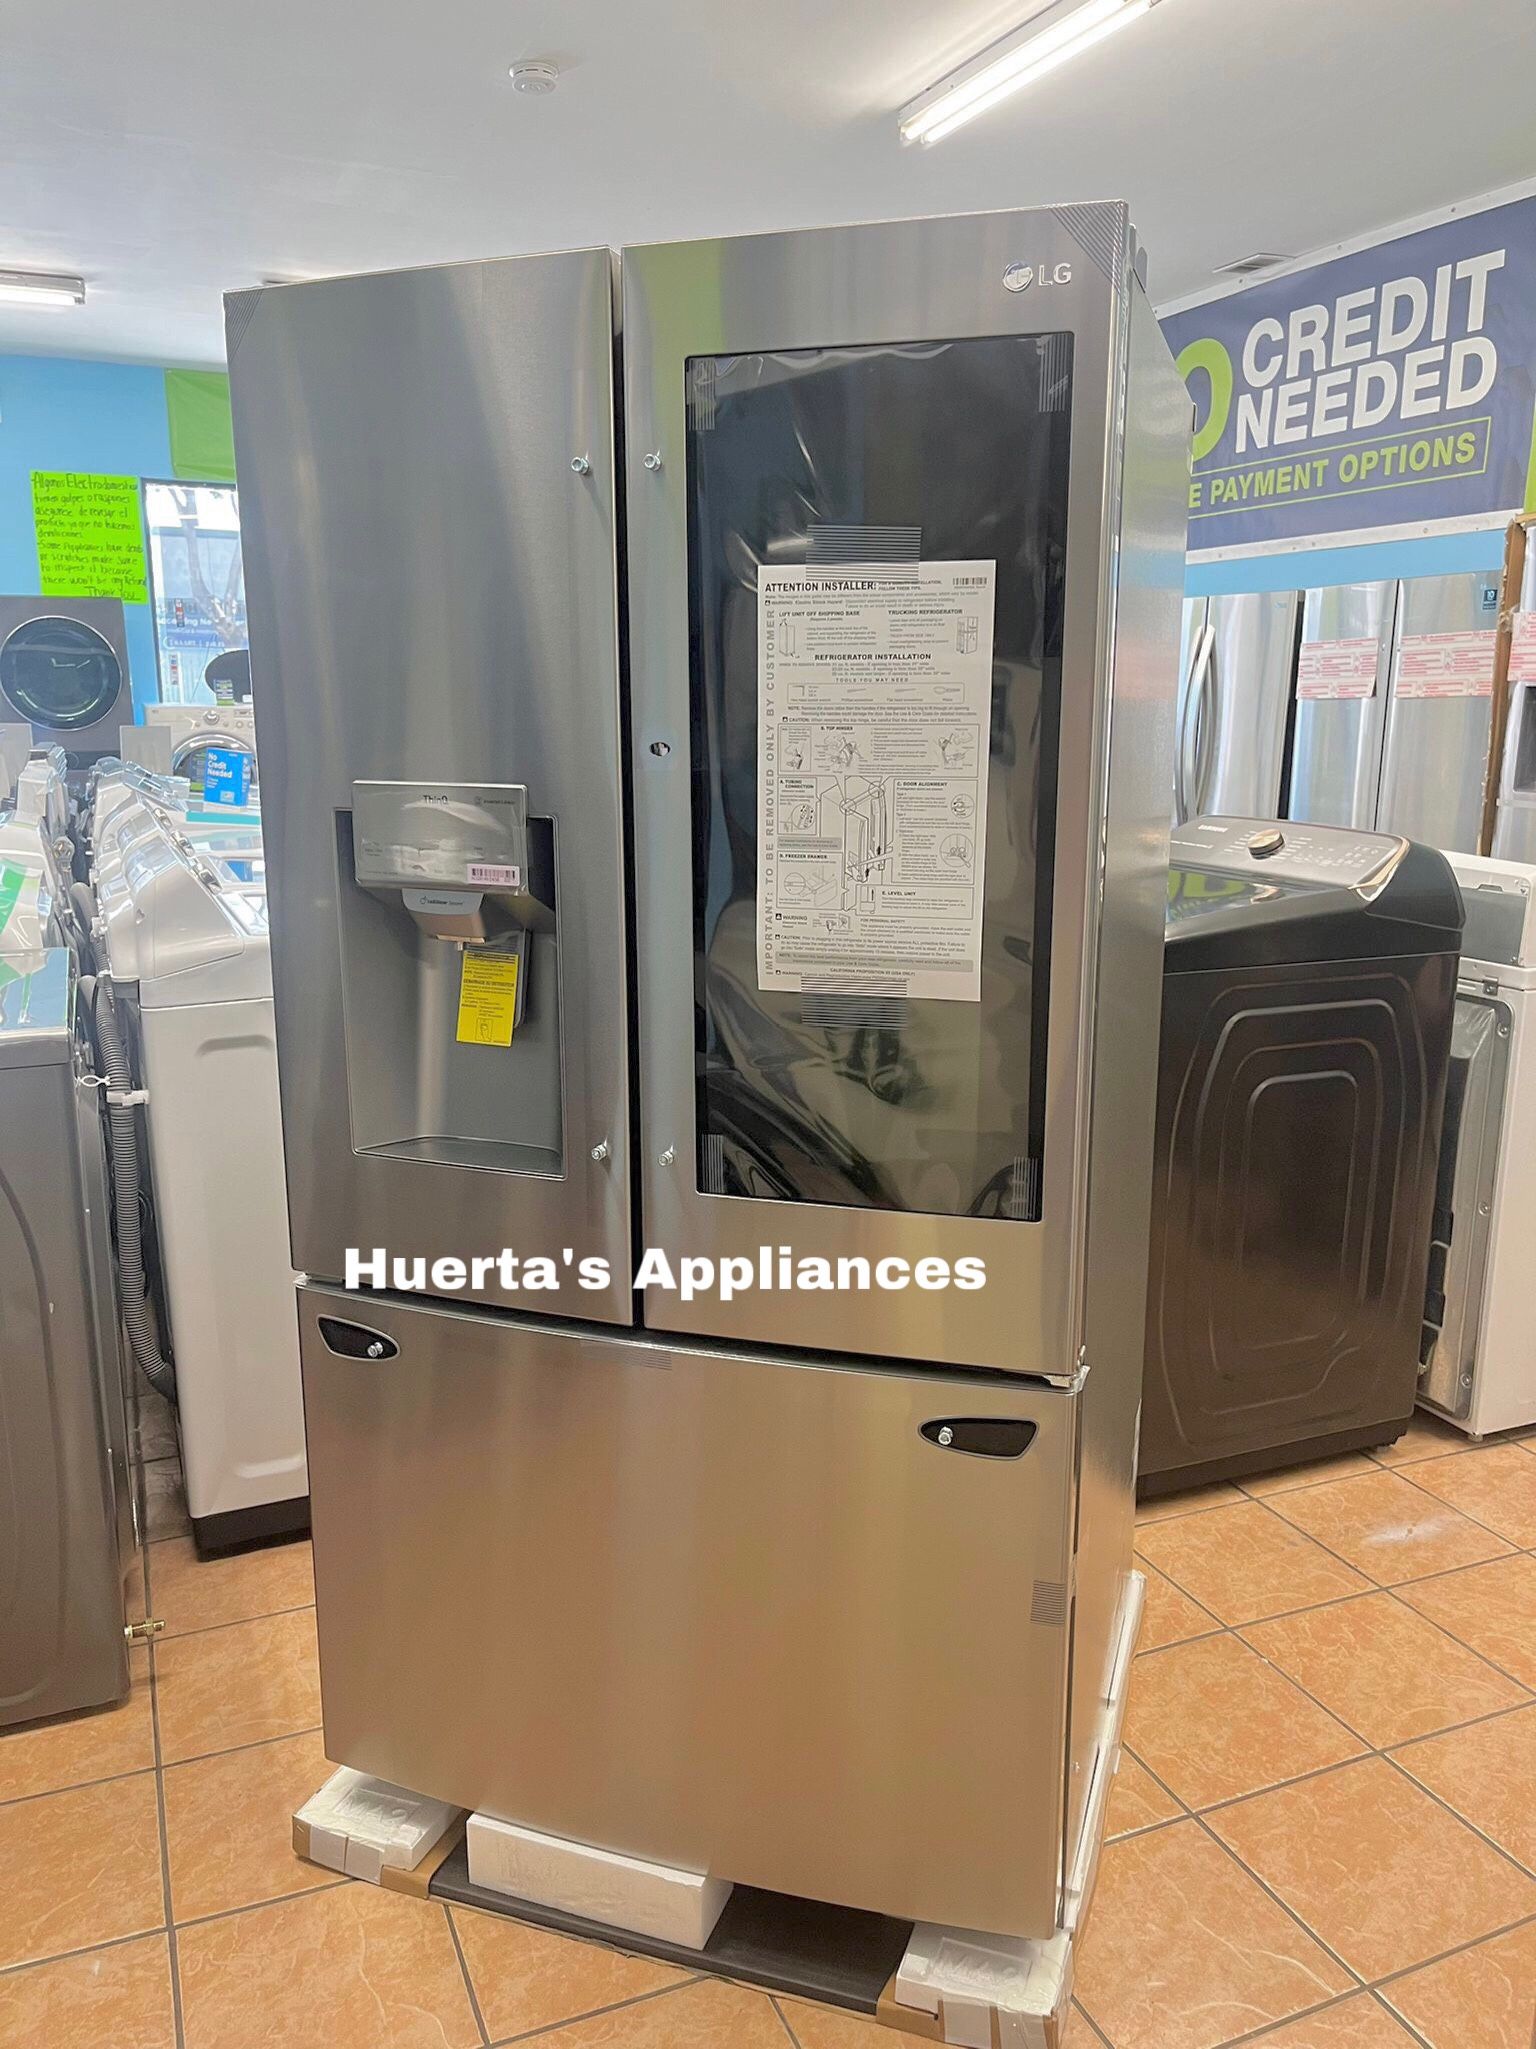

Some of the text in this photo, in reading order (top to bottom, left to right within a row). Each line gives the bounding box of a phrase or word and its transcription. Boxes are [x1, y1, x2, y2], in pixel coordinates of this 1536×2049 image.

[1038, 262, 1072, 286] LG
[1242, 249, 1505, 388] CREDIT
[1235, 336, 1497, 453] NEEDED
[1210, 459, 1329, 505] PAYMENT
[1338, 432, 1476, 483] OPTIONS
[765, 582, 818, 592] ATTENTION
[821, 581, 877, 591] INSTALLER:
[764, 609, 775, 975] IMPORTANT: TO BE REMOVED ONLY BY CUSTOMER
